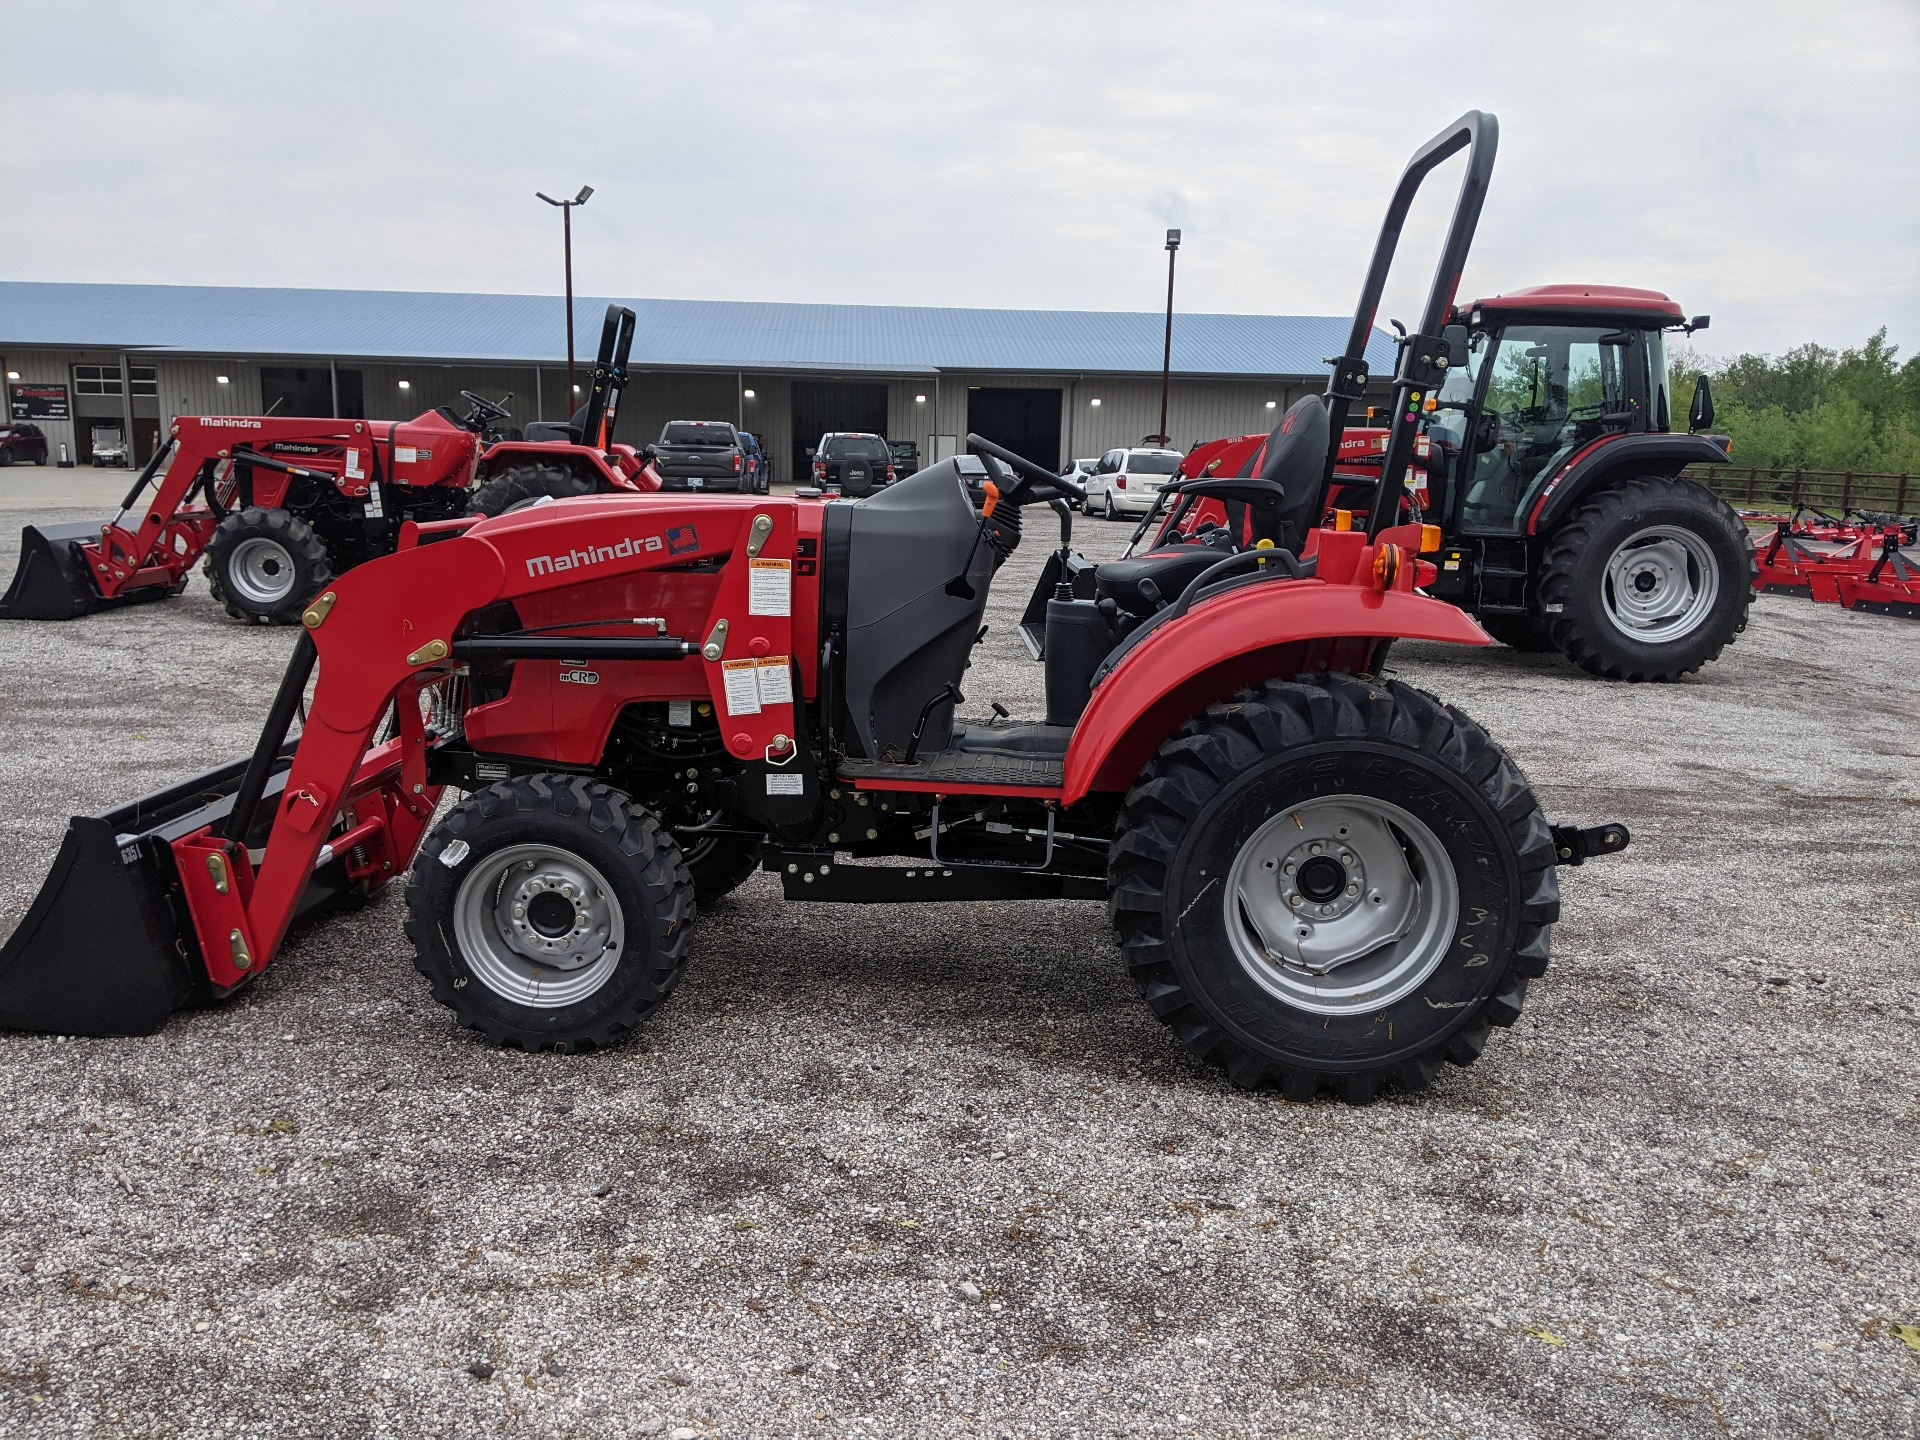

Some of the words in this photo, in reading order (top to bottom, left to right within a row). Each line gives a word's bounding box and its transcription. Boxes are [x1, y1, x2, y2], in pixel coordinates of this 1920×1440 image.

[200, 417, 261, 428] Mahindra
[275, 443, 318, 453] Mahindra
[525, 534, 663, 578] Mahindra
[1360, 758, 1507, 907] LOADER
